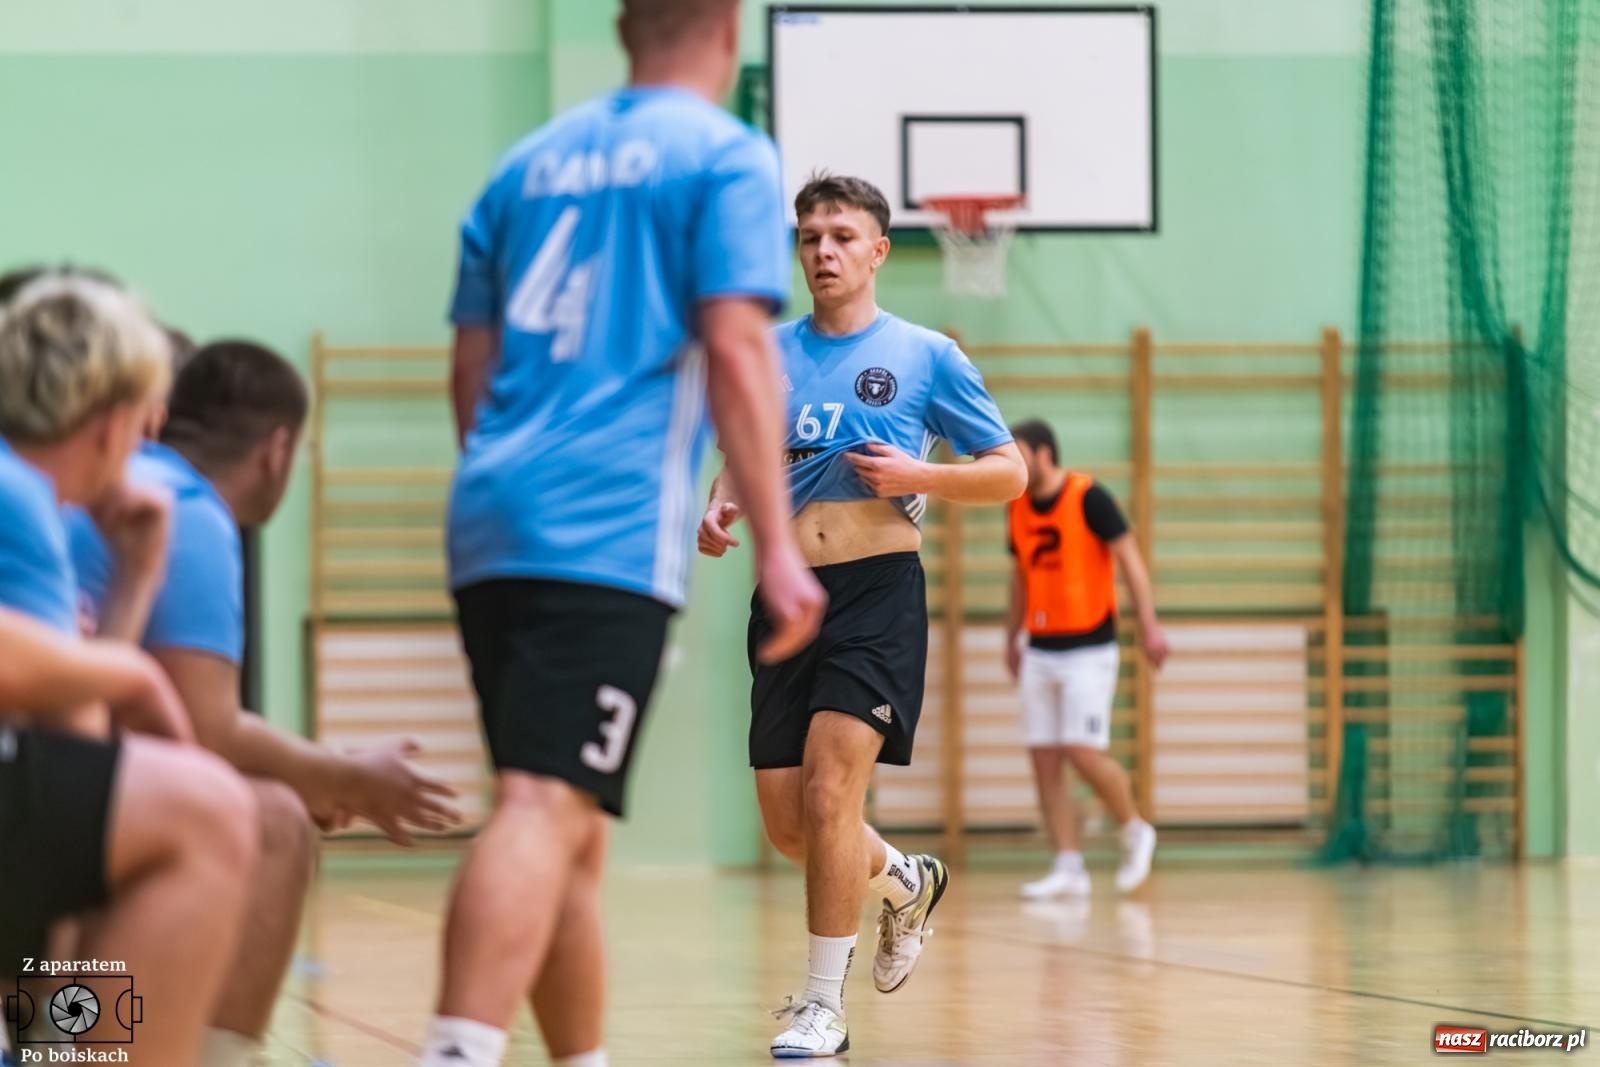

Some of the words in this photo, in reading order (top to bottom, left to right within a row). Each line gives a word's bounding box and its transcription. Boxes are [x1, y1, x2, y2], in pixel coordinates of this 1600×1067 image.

[796, 402, 845, 441] 67
[1027, 525, 1062, 570] 2
[580, 684, 638, 774] 3
